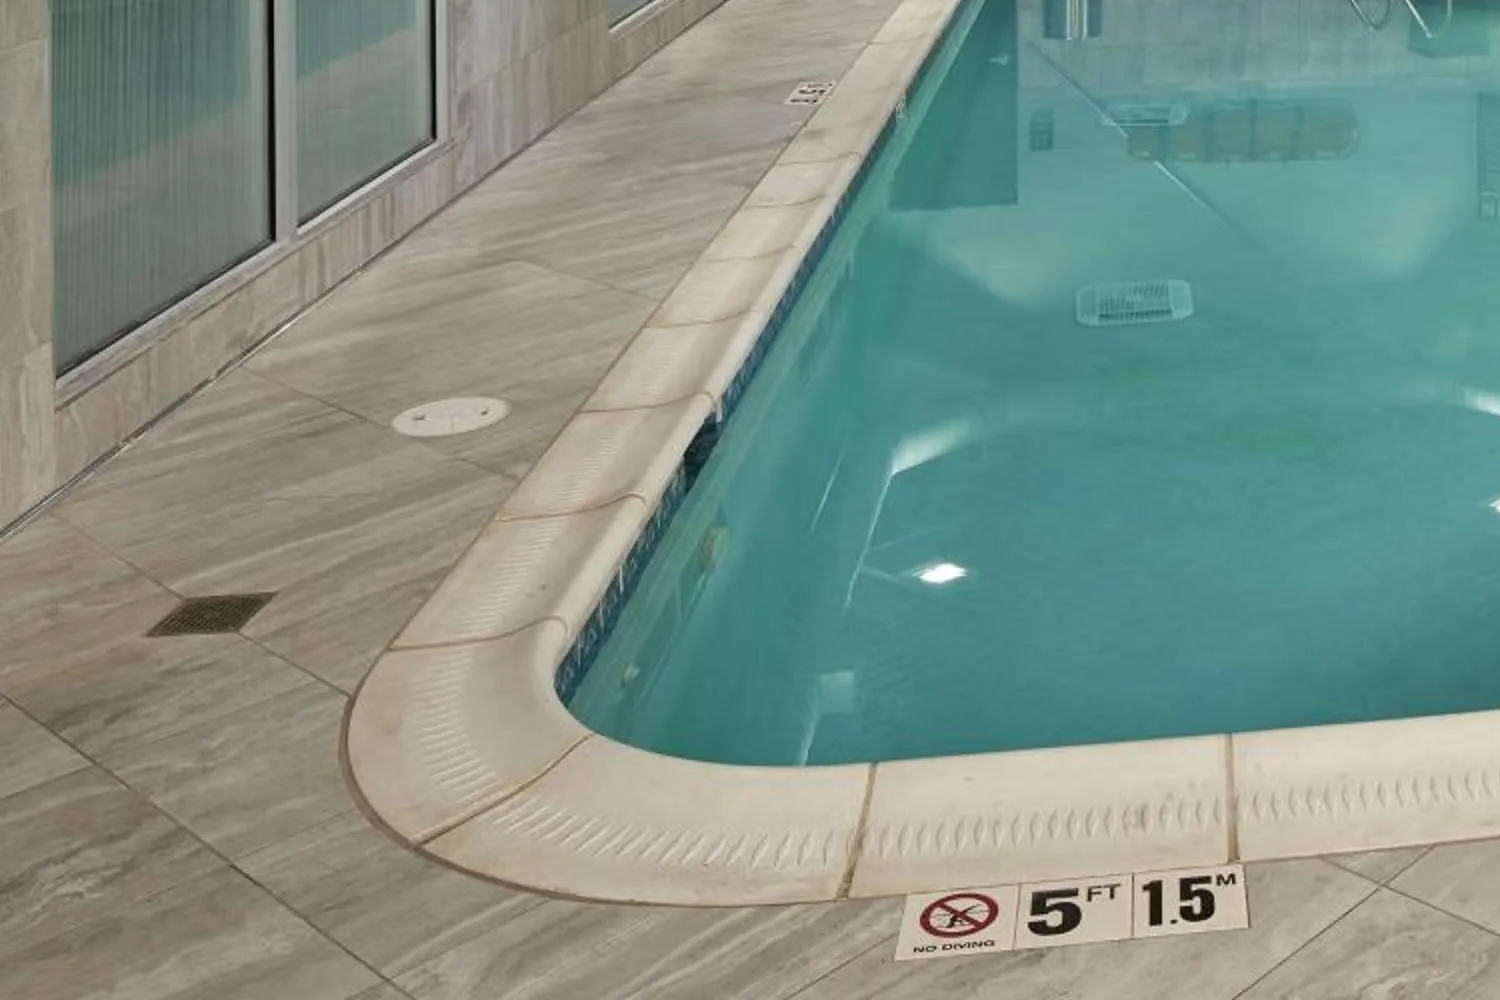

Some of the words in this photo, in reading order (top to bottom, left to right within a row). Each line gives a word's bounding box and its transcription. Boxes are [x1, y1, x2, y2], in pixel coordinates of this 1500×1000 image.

[1027, 887, 1083, 937] 5
[1086, 883, 1122, 902] FT
[1142, 875, 1216, 927] 1.5
[1215, 873, 1238, 887] M
[913, 945, 937, 953] NO
[941, 940, 996, 951] DIVING
